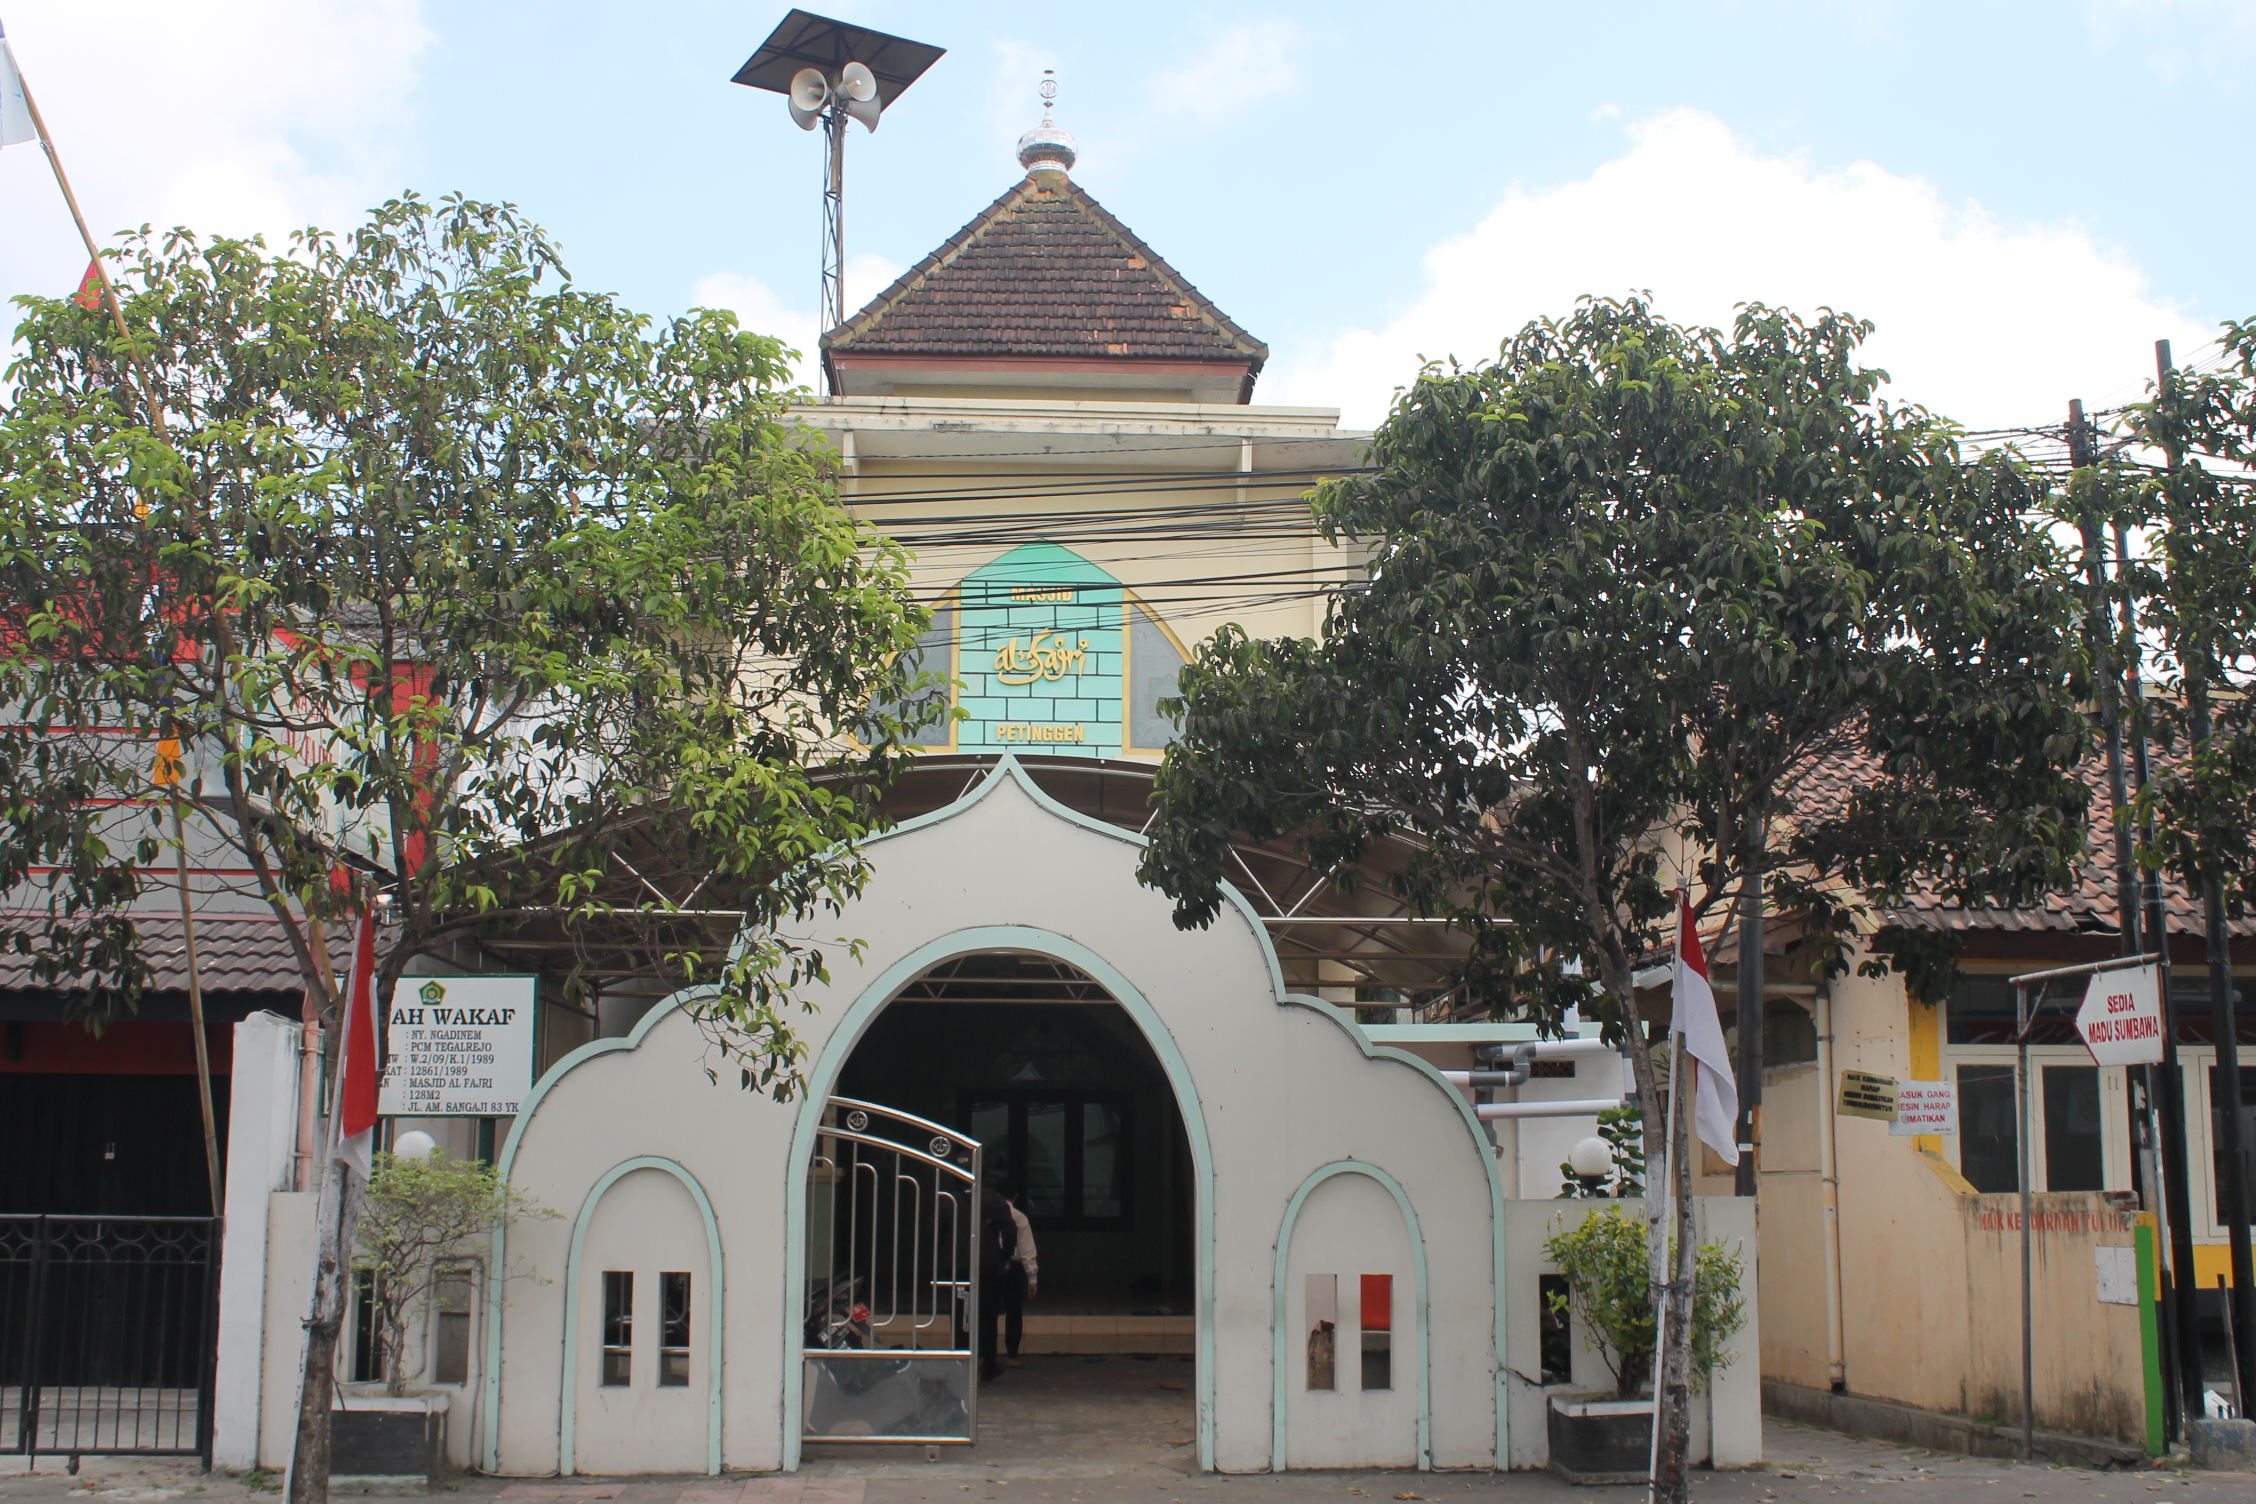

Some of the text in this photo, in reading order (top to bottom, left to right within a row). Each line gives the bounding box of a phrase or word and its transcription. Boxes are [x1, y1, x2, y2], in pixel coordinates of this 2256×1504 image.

[1011, 587, 1072, 602] MASJID
[996, 725, 1084, 742] PETINGGEN
[2108, 993, 2135, 1014] SEDIA
[432, 1008, 516, 1025] WAKAF
[412, 1030, 482, 1040] NY. NGADINEM
[2089, 1020, 2112, 1044] MADU
[2114, 1016, 2159, 1041] SUMBAWA
[411, 1042, 492, 1052] PCM TEGALREJO
[410, 1066, 468, 1076] 12861/1989
[410, 1078, 492, 1088] MASJID AL FAJRI
[409, 1090, 440, 1100] 128M2
[1898, 1090, 1950, 1099] ASUK GANG
[408, 1102, 519, 1112] JL. AM. SANGAJI 83 YK
[1898, 1102, 1950, 1111] ESIN HARAP
[1901, 1115, 1946, 1123] DIMATIKAN
[1980, 1212, 2004, 1230] NAIK
[2006, 1212, 2080, 1232] KEDARAAN
